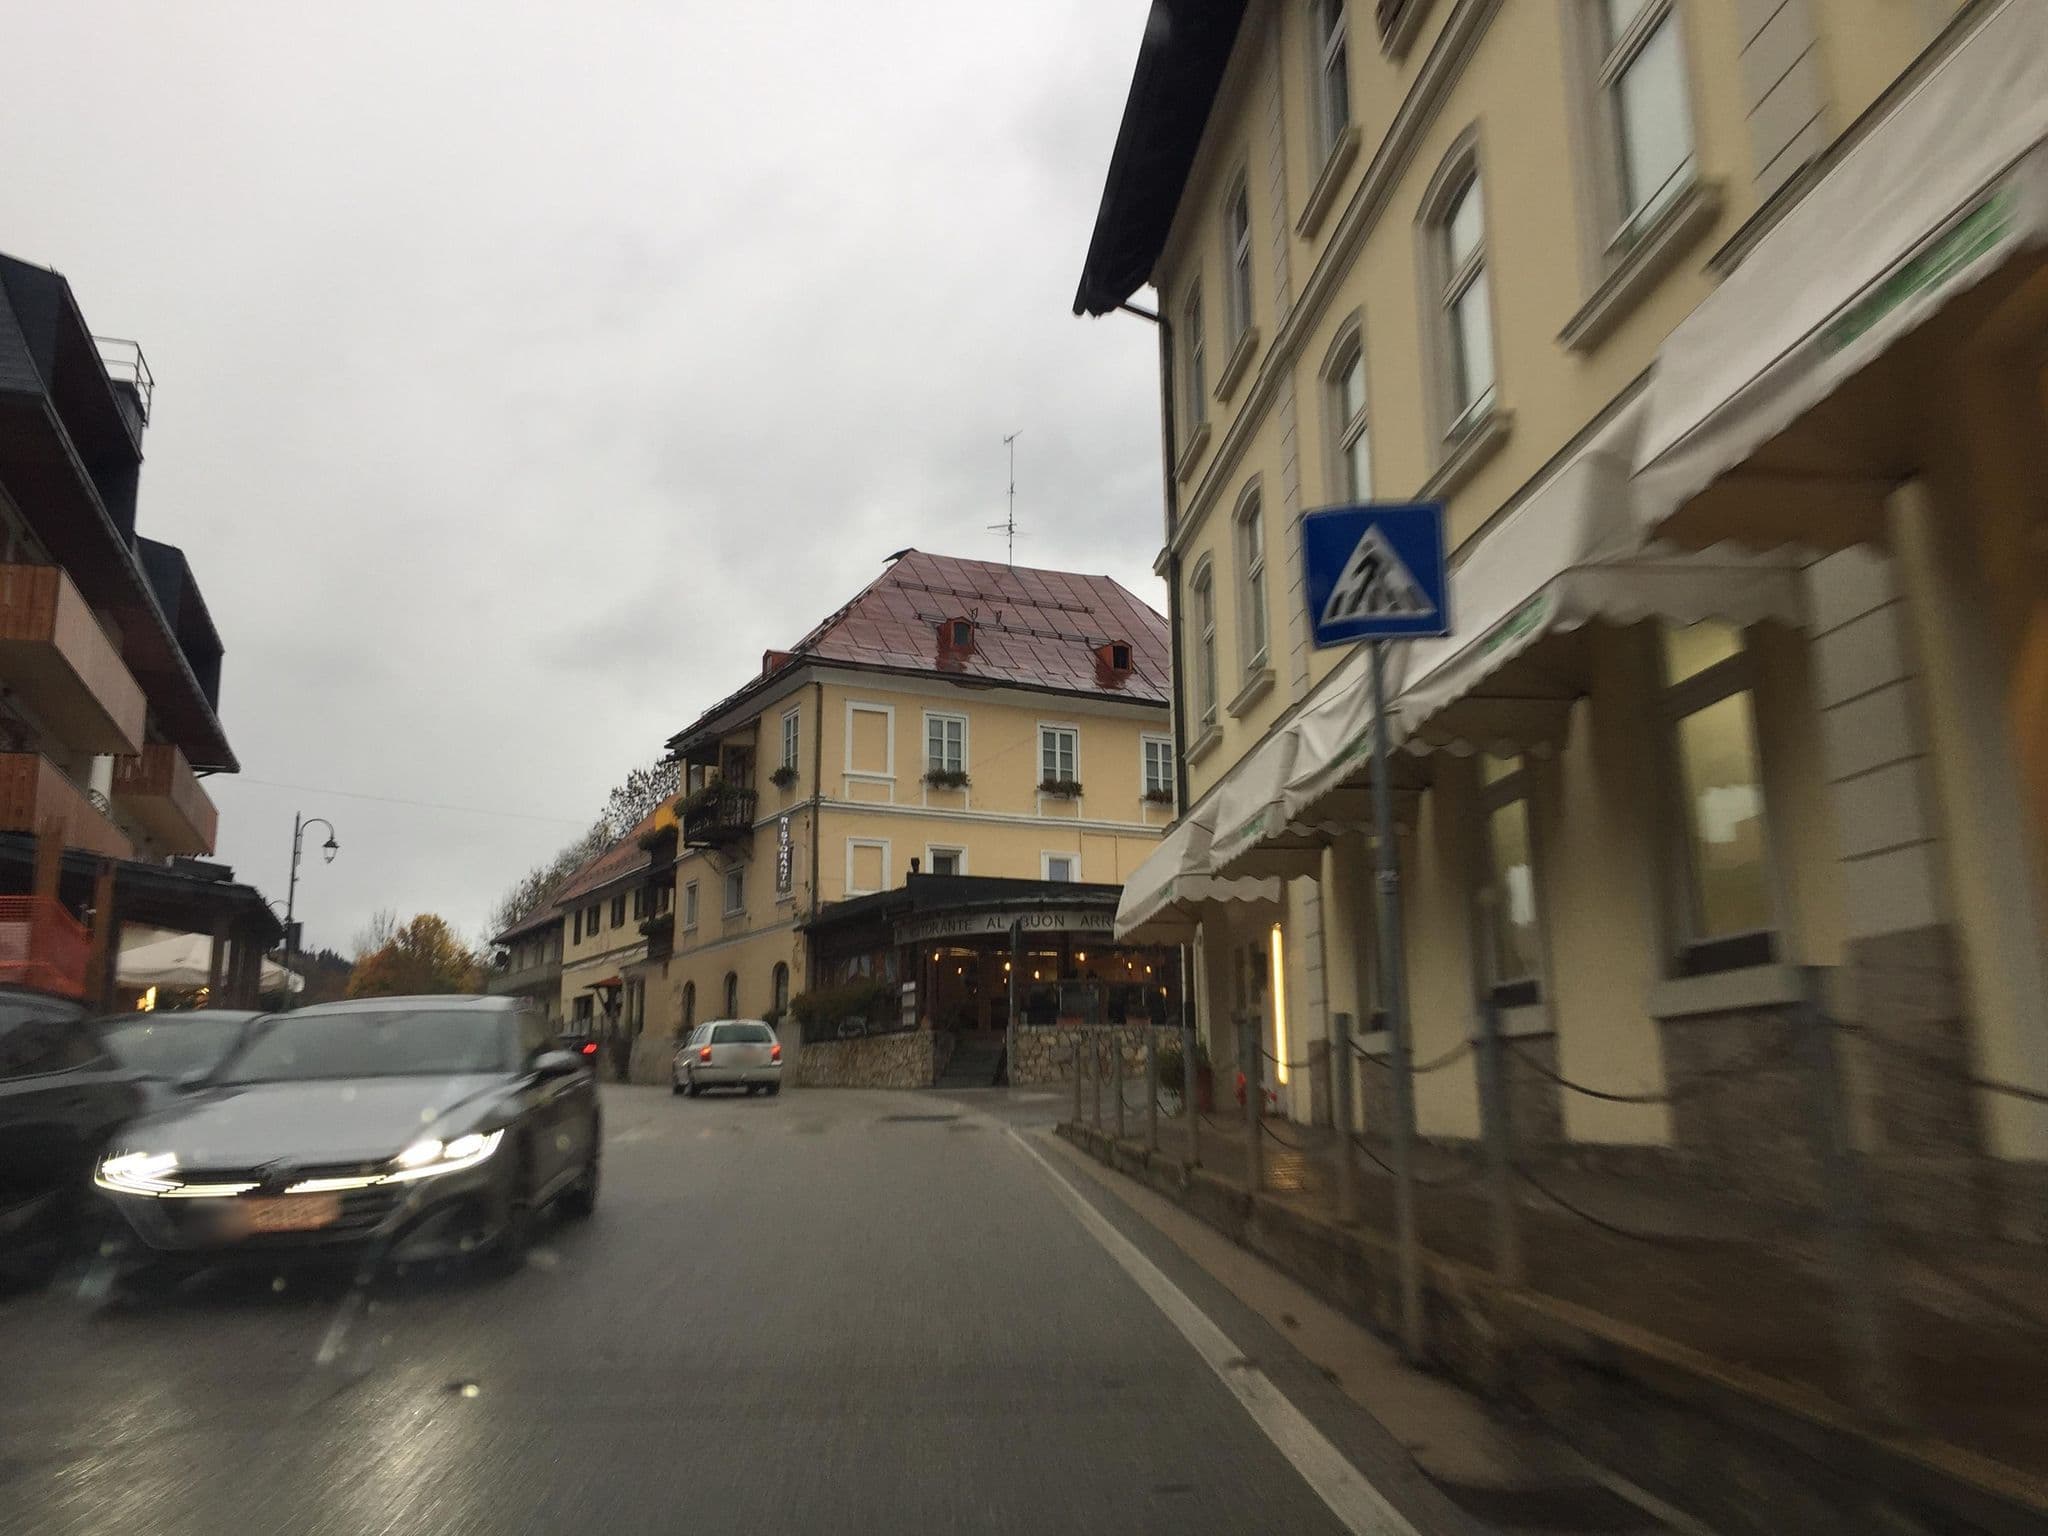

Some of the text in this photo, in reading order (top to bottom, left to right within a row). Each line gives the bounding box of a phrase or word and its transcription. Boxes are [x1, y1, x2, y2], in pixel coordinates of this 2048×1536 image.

[779, 815, 789, 888] RISTORANTE
[985, 914, 1005, 930] AL
[1020, 913, 1065, 929] BUON
